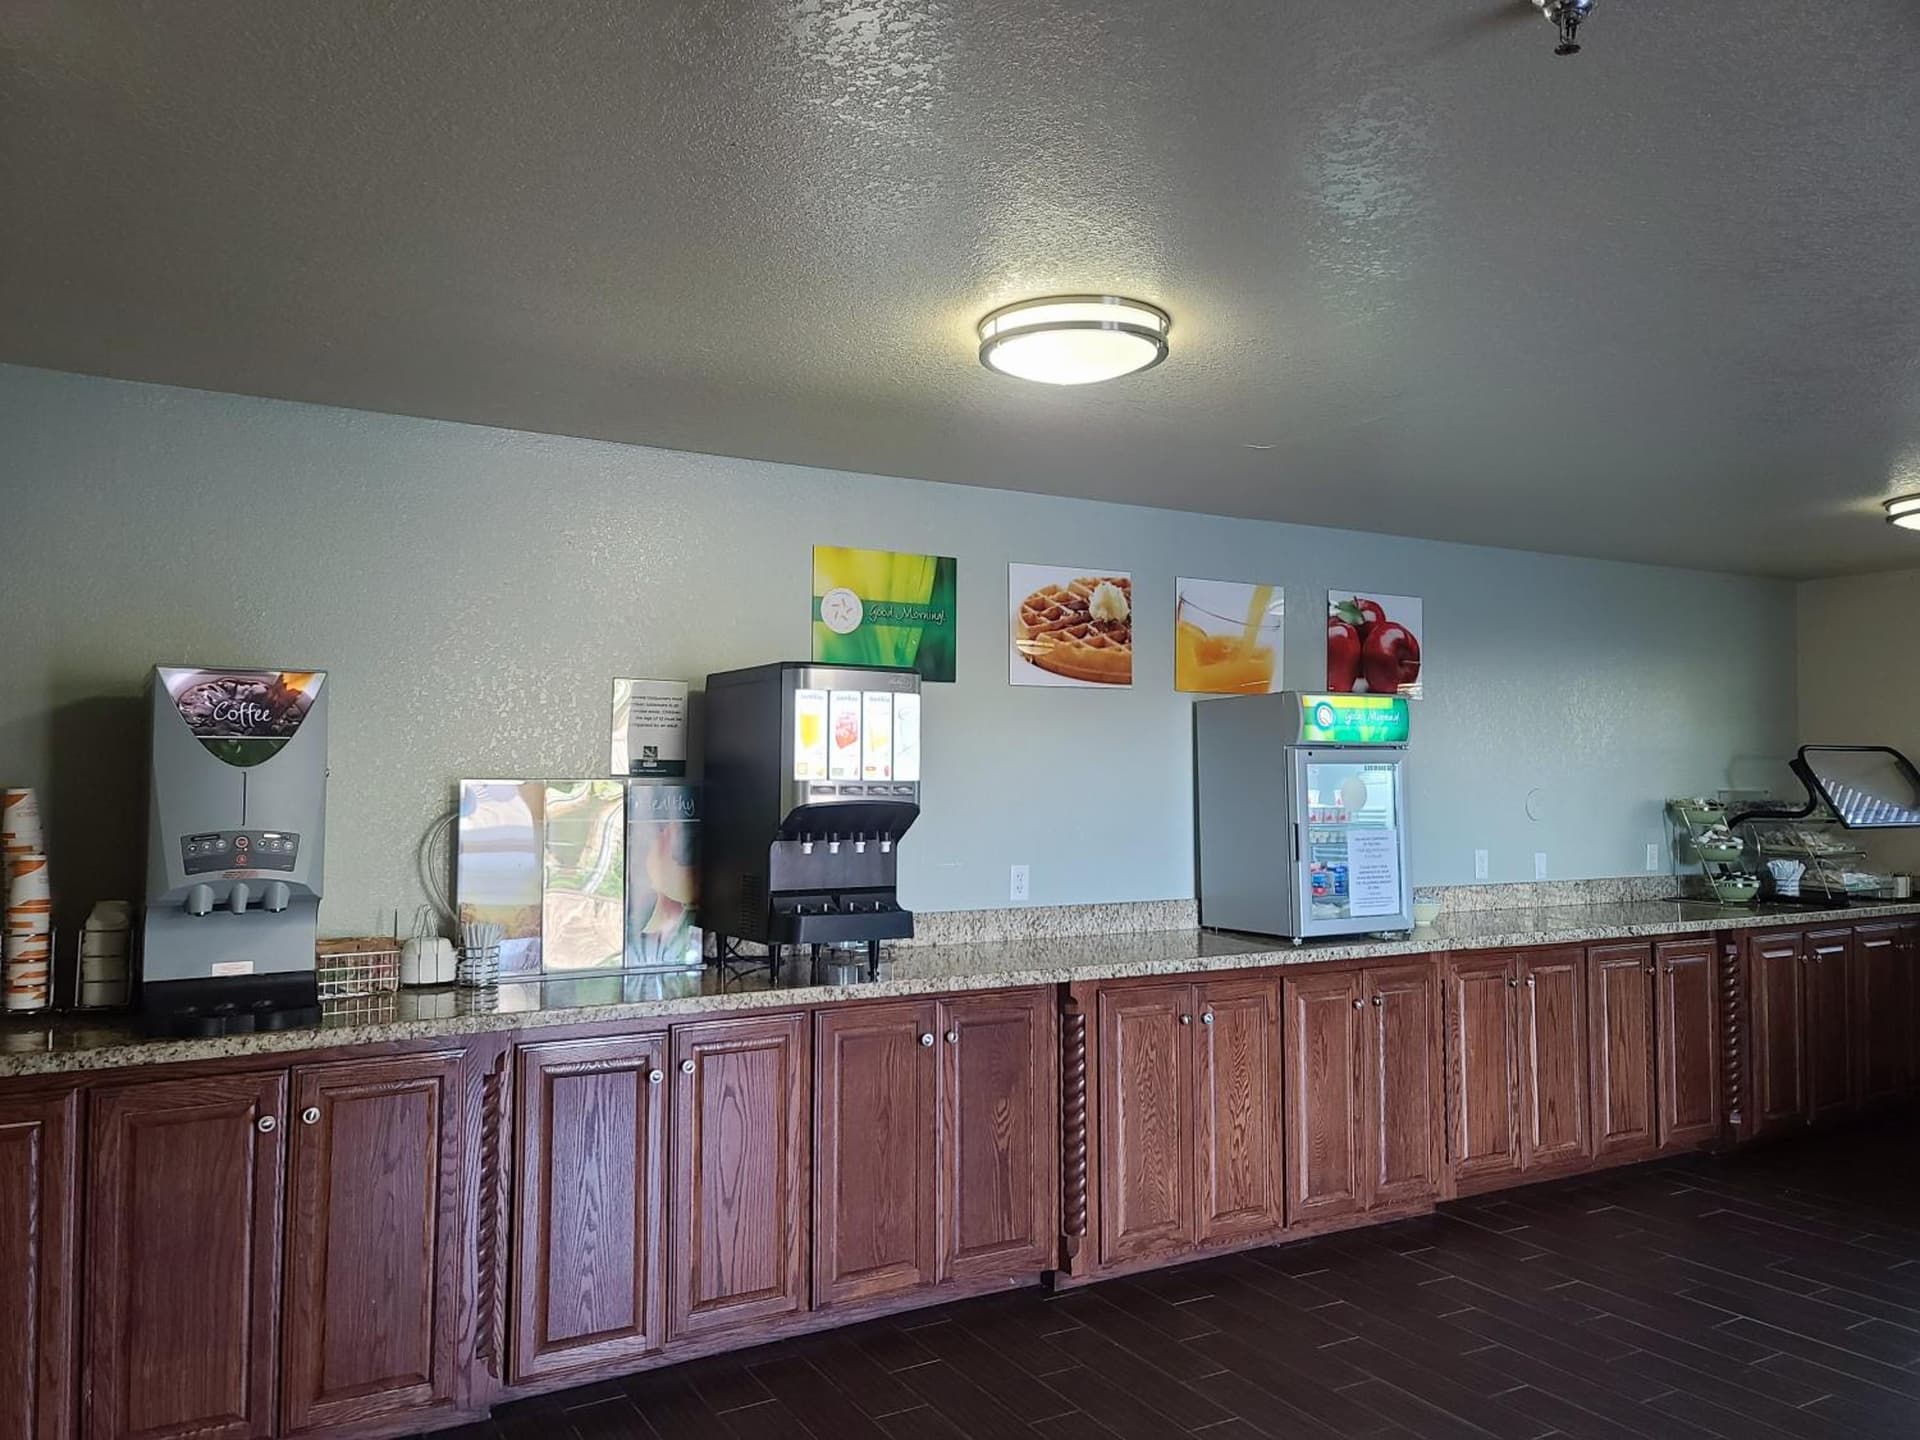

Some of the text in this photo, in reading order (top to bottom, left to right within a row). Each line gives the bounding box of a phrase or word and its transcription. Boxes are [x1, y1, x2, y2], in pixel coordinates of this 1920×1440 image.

[870, 604, 893, 622] Good
[213, 701, 272, 727] Coffee
[643, 794, 696, 818] ealthy
